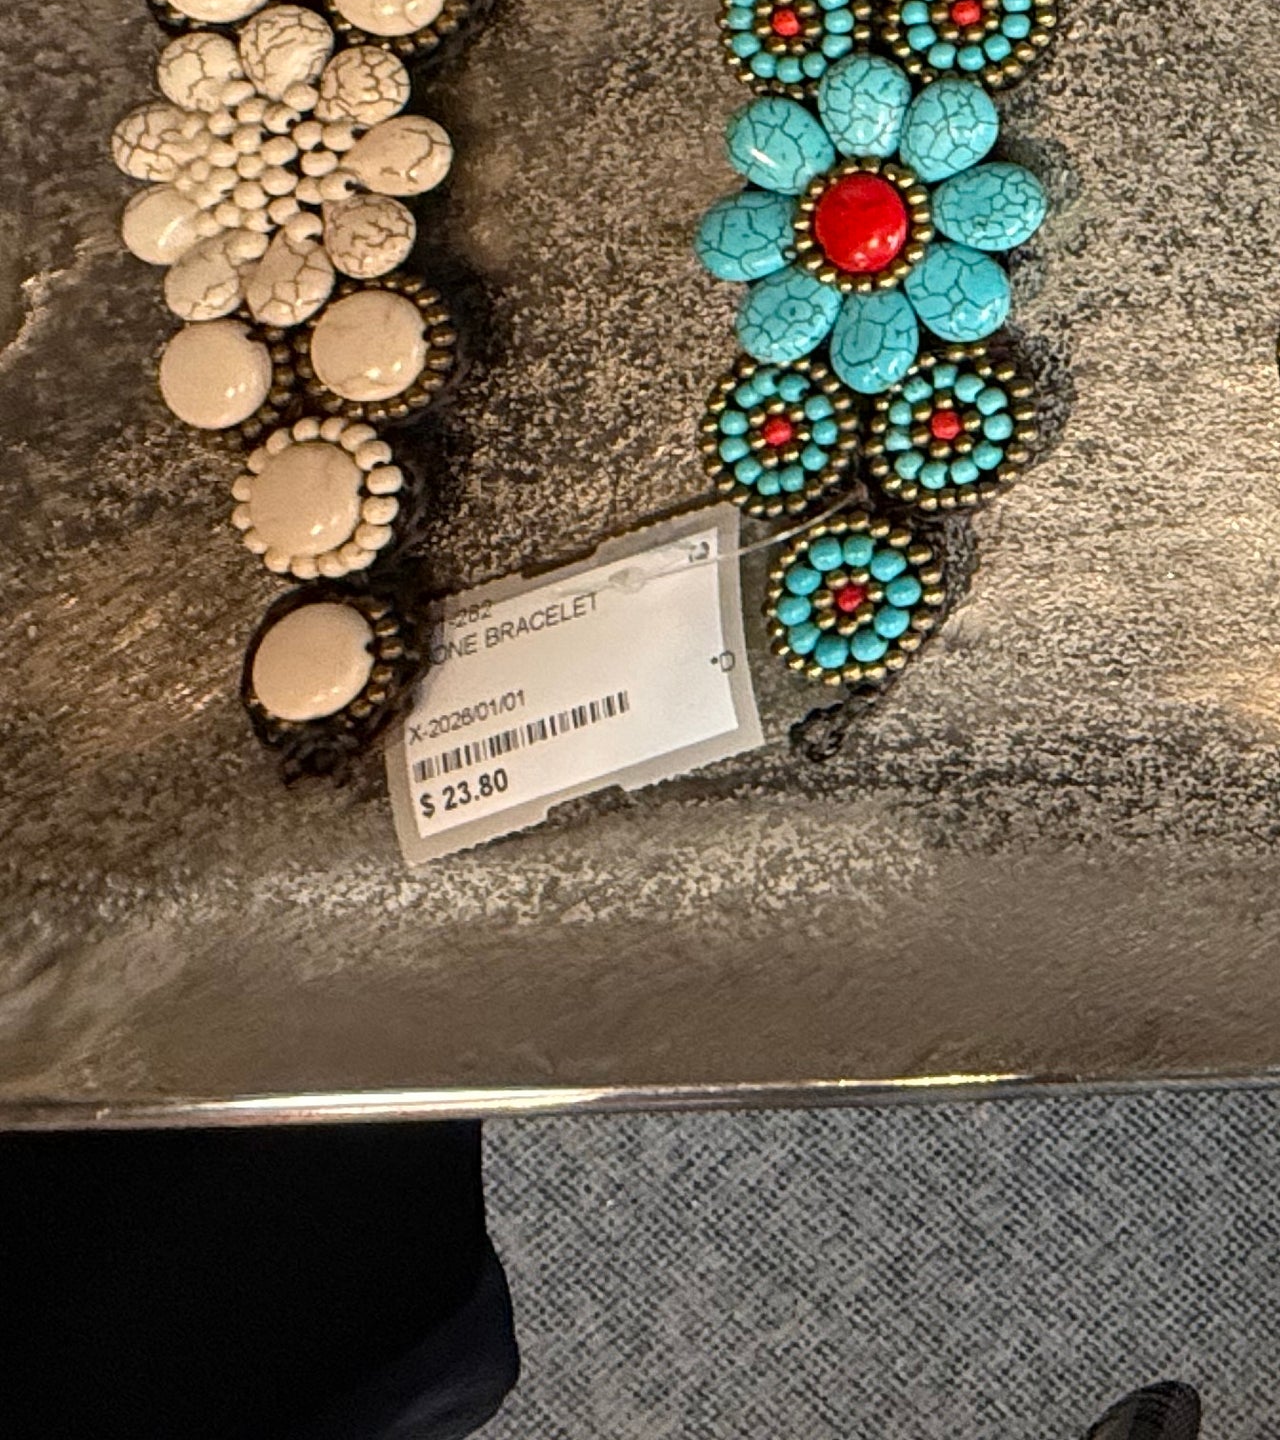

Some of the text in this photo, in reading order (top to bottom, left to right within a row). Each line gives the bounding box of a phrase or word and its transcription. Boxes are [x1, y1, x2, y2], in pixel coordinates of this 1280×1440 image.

[430, 591, 599, 665] ONE BRACELET
[419, 767, 508, 819] $ 23.80
